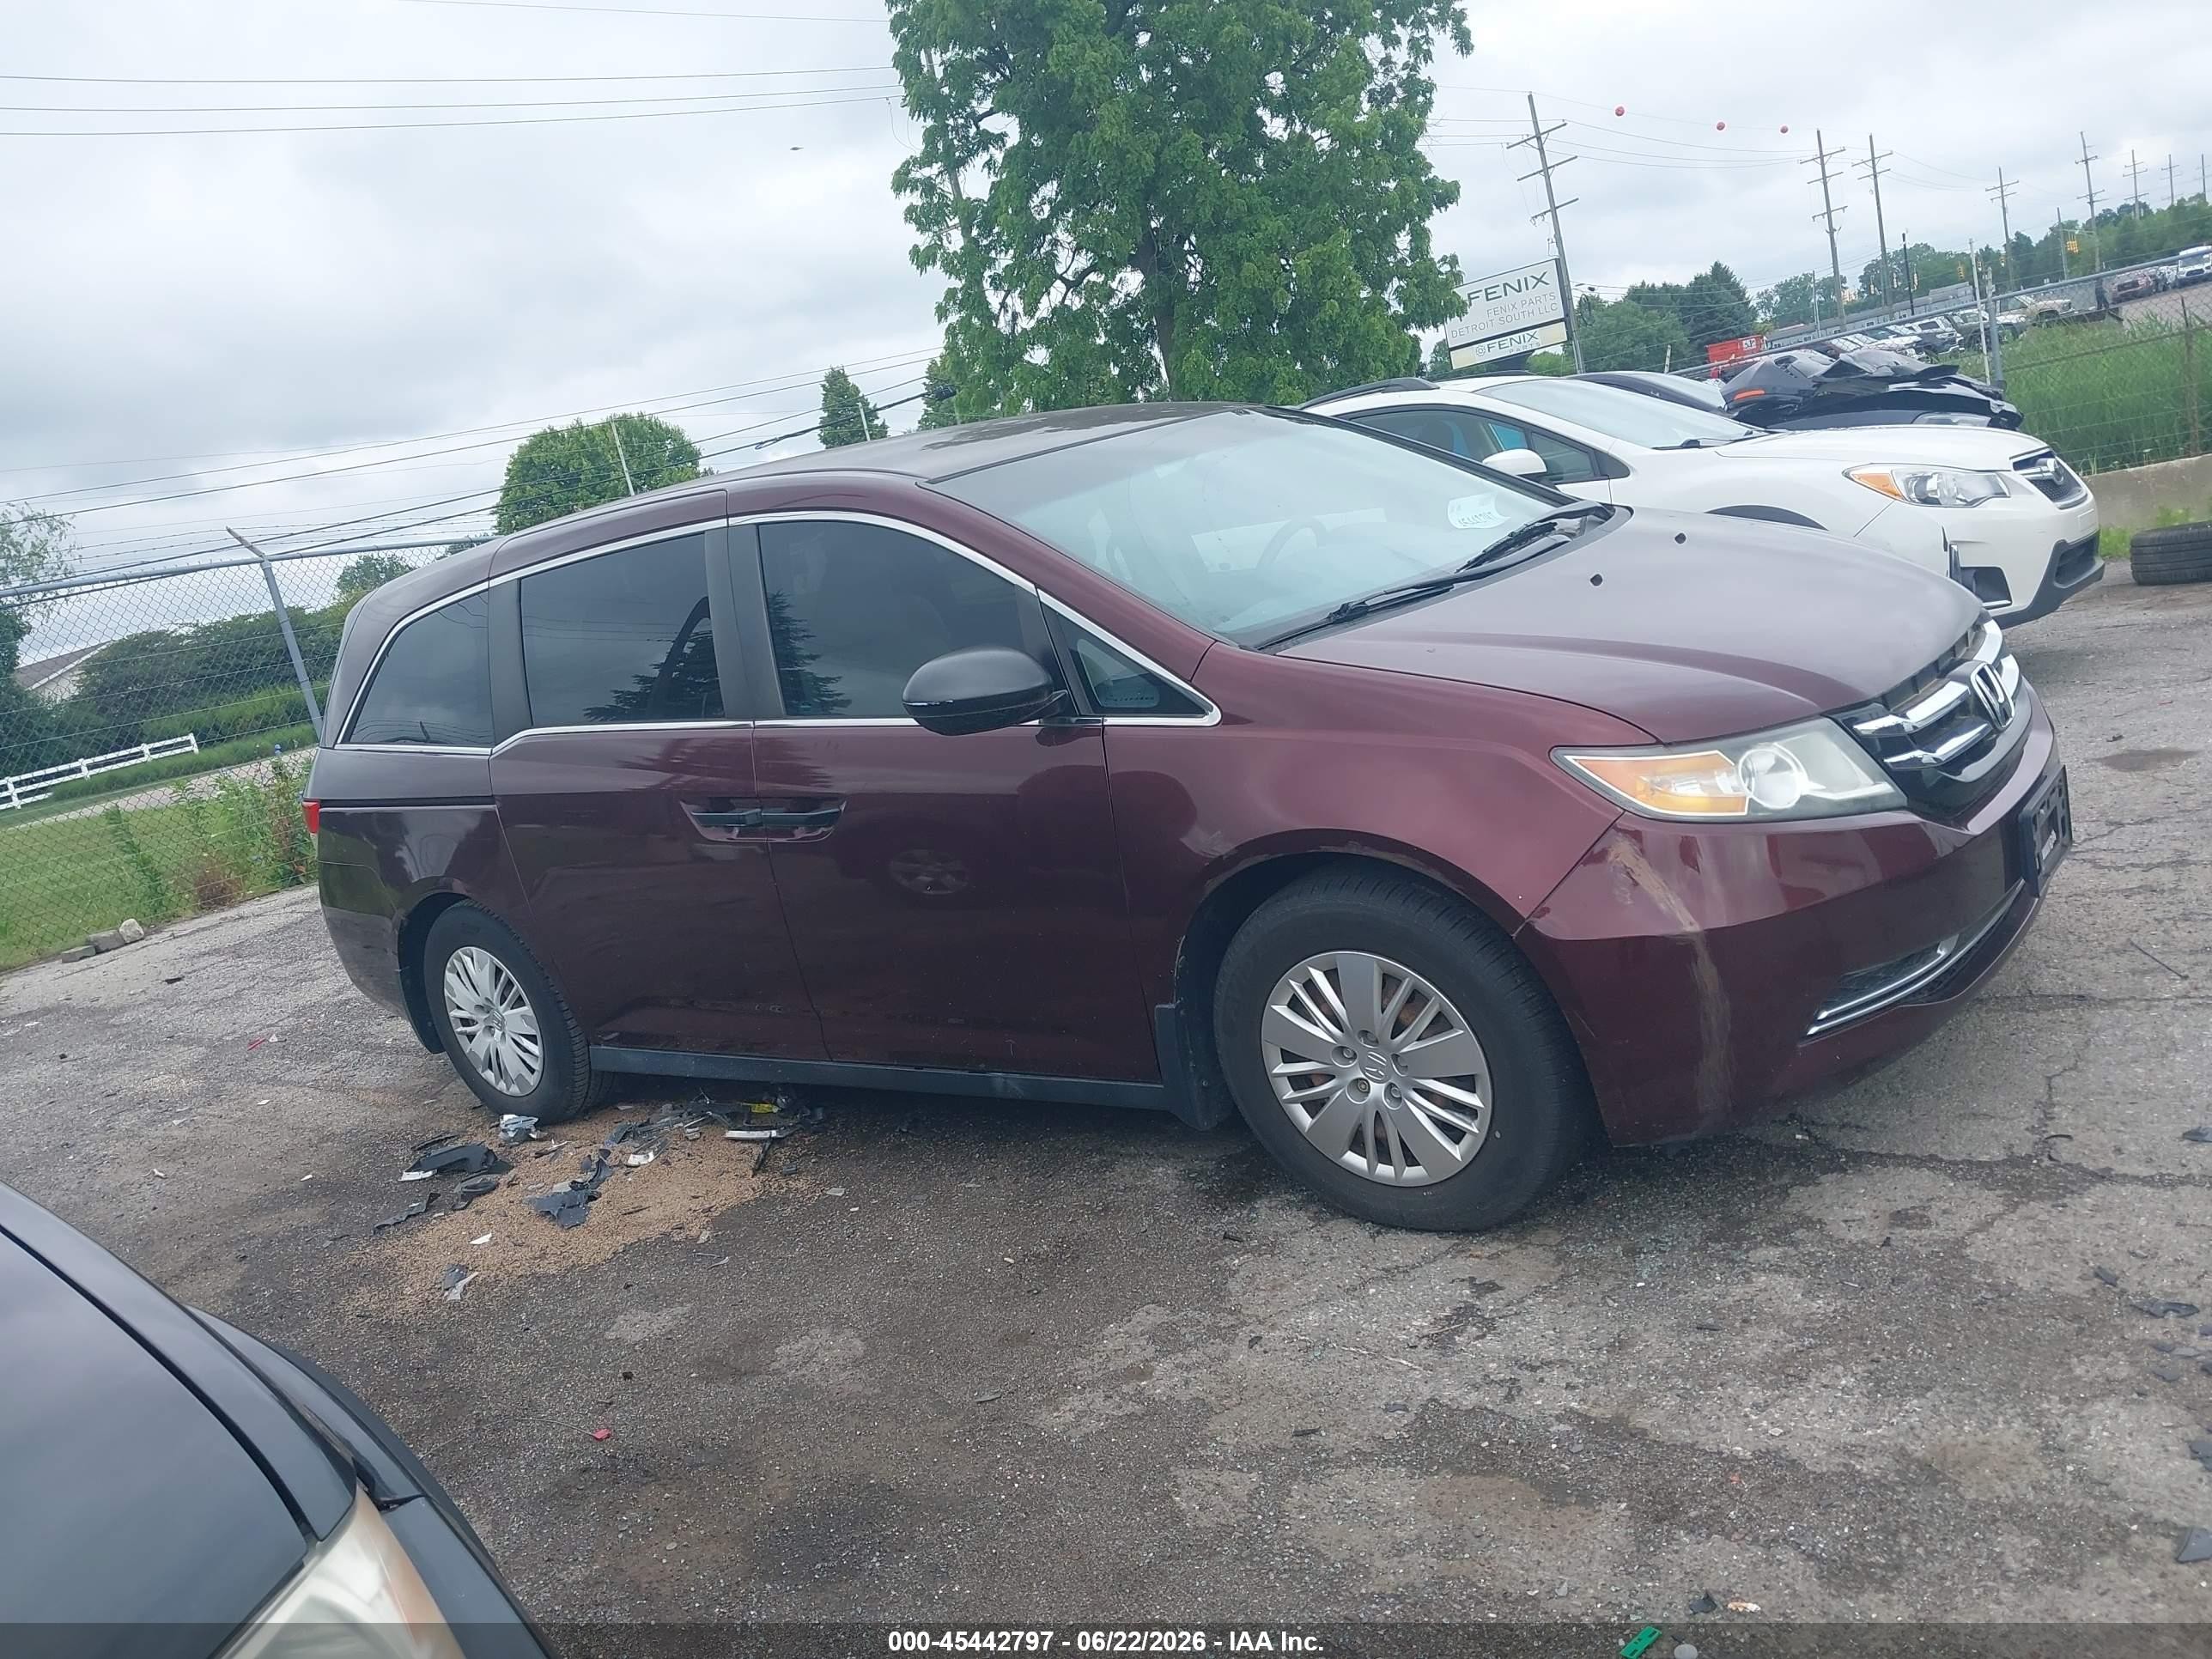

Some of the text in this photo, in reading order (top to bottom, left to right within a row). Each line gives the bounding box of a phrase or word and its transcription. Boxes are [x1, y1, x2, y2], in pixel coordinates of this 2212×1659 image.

[1468, 270, 1550, 307] FENIX
[1486, 292, 1556, 318] FENIX PARTS
[1451, 302, 1559, 338] DETROIT SOUTH LLC
[1487, 331, 1539, 353] FENIX
[1509, 342, 1541, 355] PARTS
